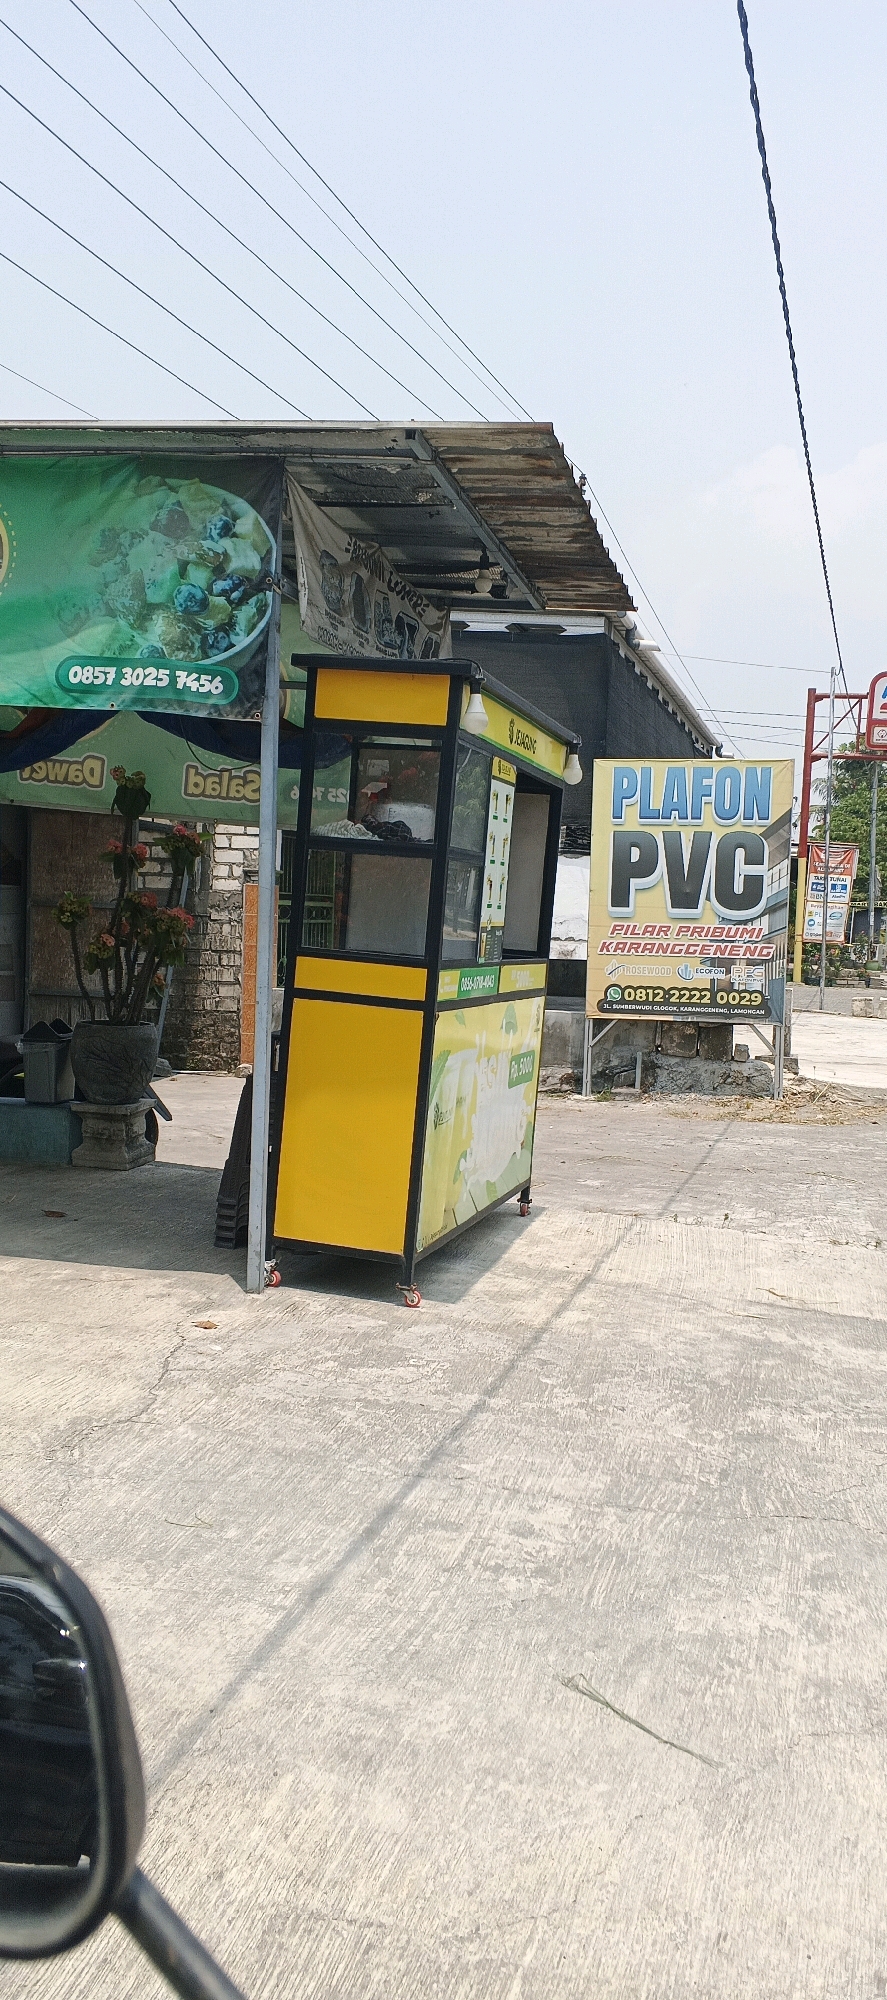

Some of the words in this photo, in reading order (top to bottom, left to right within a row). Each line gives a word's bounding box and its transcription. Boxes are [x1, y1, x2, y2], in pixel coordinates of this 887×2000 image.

[68, 666, 117, 685] 0857
[120, 666, 169, 688] 3025
[175, 670, 224, 695] 7456
[612, 766, 773, 823] PLAFON
[609, 830, 769, 915] PVC
[609, 923, 672, 937] PILAR
[675, 925, 764, 940] PRIBUMI
[599, 941, 775, 958] KARANGGENENG
[626, 965, 672, 976] ROSEWOOD
[695, 967, 725, 975] ECOFON
[623, 988, 664, 1002] 0812
[669, 990, 711, 1004] 2222
[716, 992, 762, 1006] 0029
[519, 1054, 533, 1076] 5000
